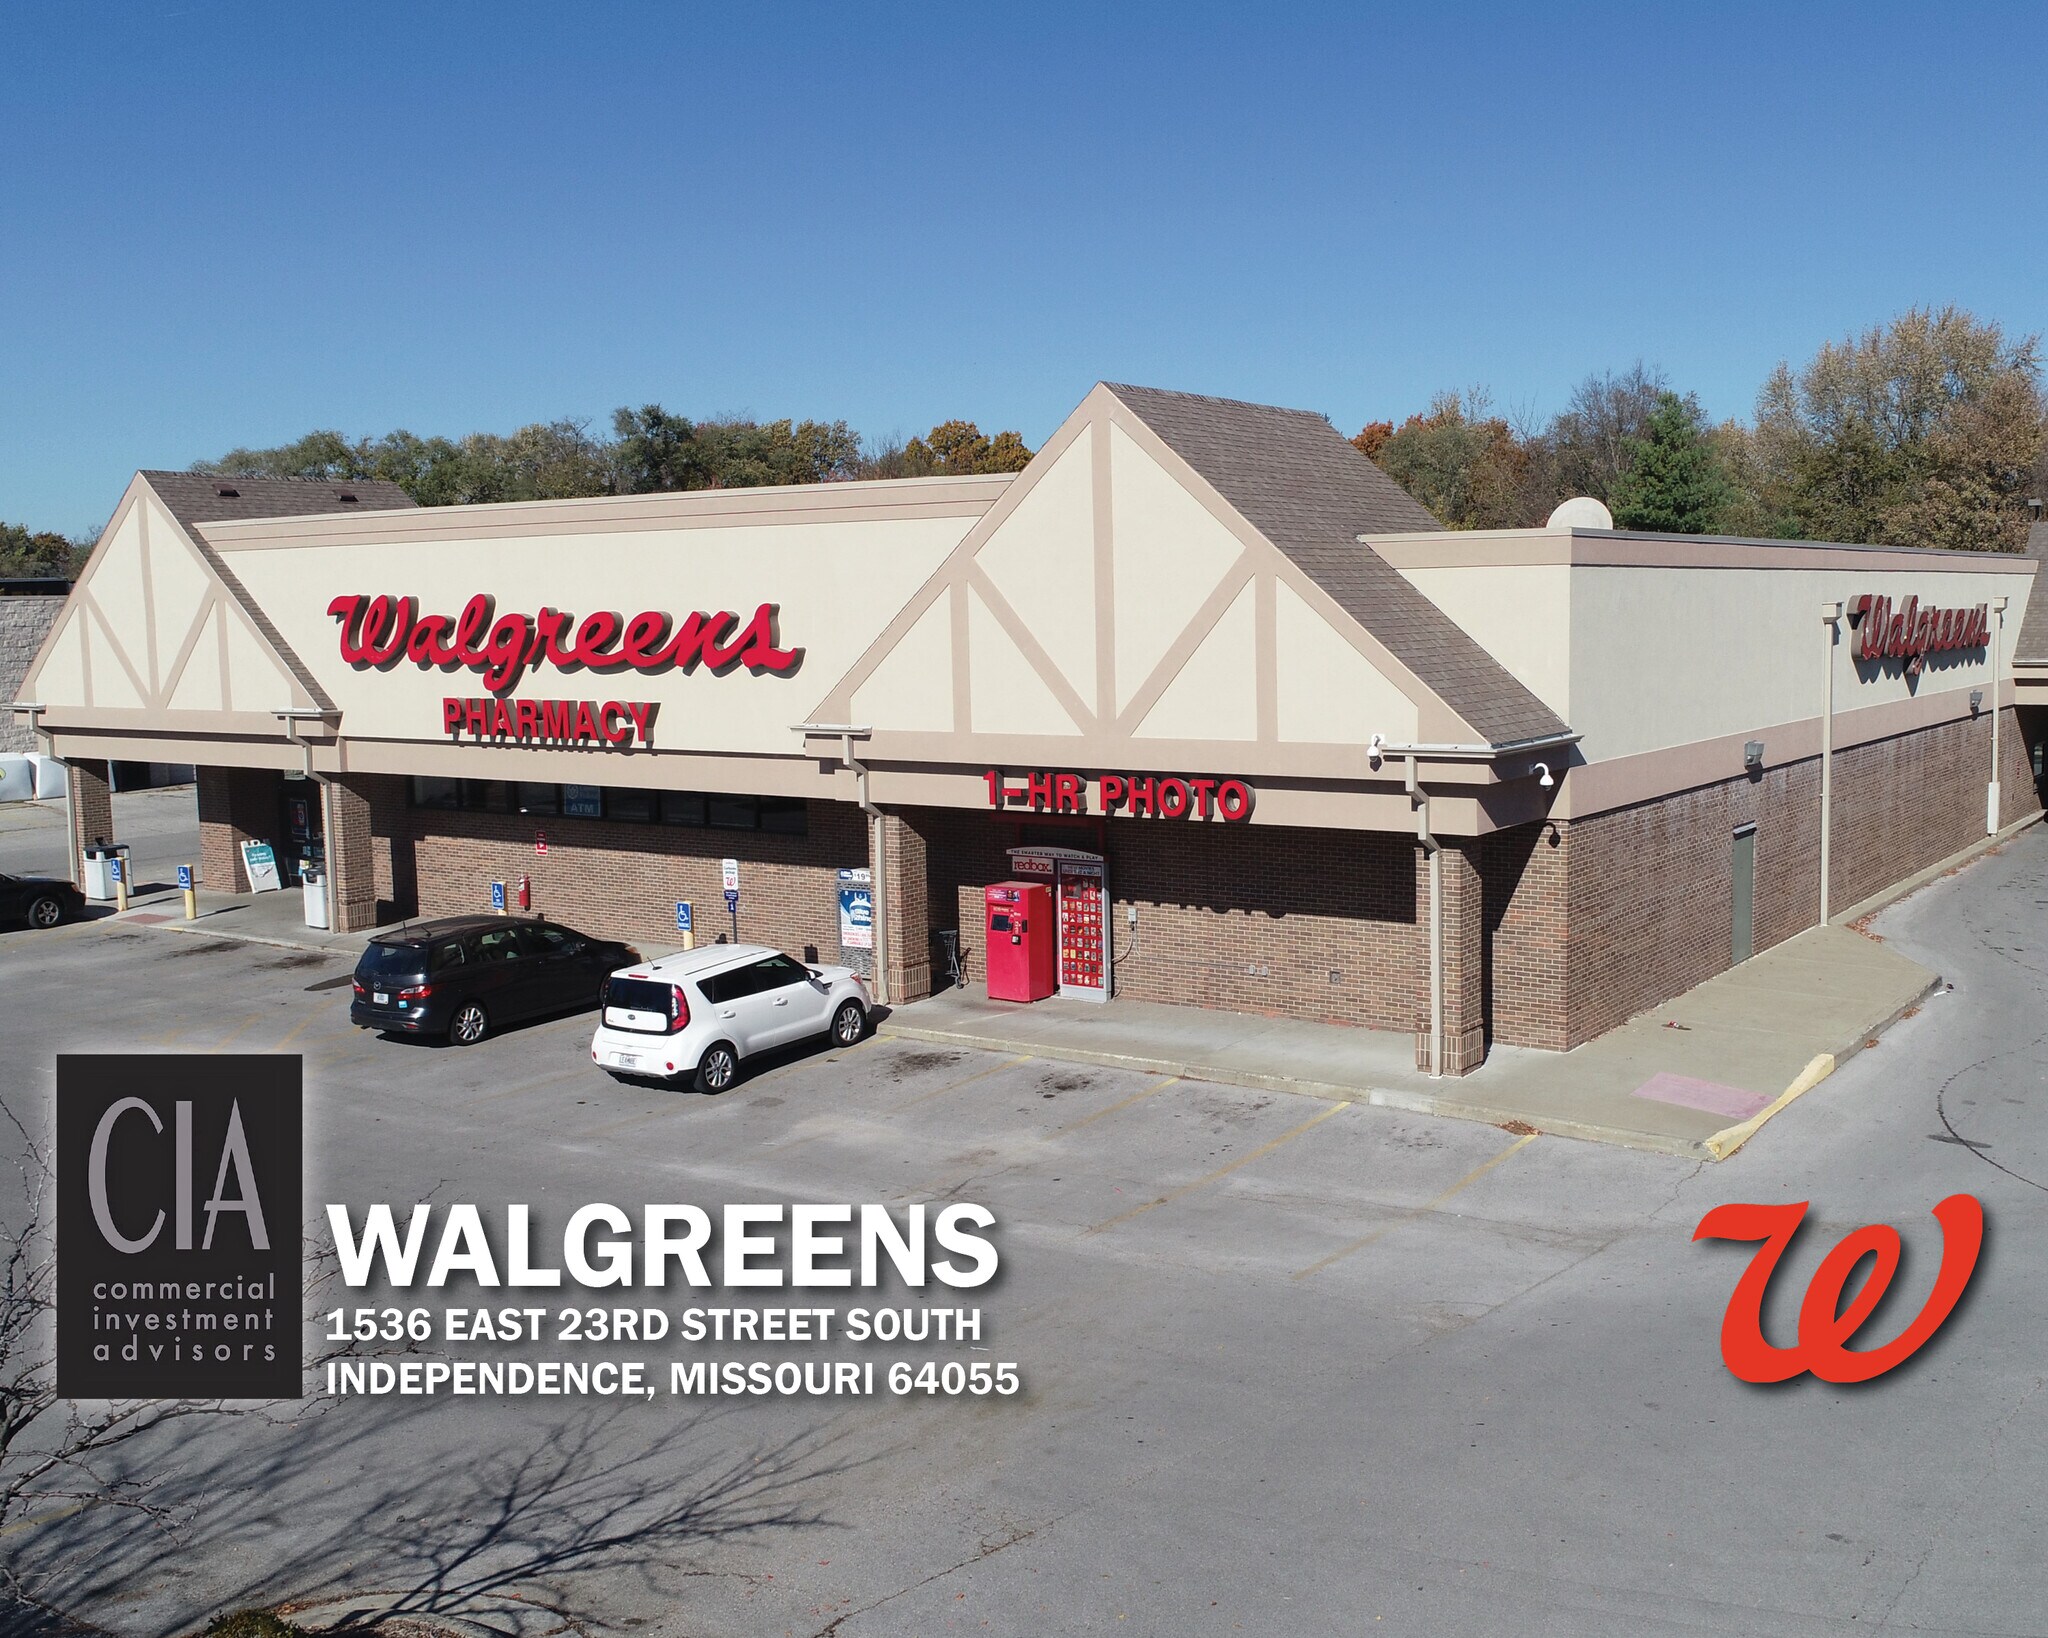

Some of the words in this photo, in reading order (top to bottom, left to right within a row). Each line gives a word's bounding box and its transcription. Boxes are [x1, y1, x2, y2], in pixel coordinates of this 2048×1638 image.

[327, 593, 798, 692] Walgreens
[1852, 594, 1991, 676] Walgreens
[443, 697, 653, 742] PHARMACY
[571, 803, 594, 814] ATM
[983, 770, 1081, 811] 1-HR
[1100, 775, 1250, 820] PHOTO
